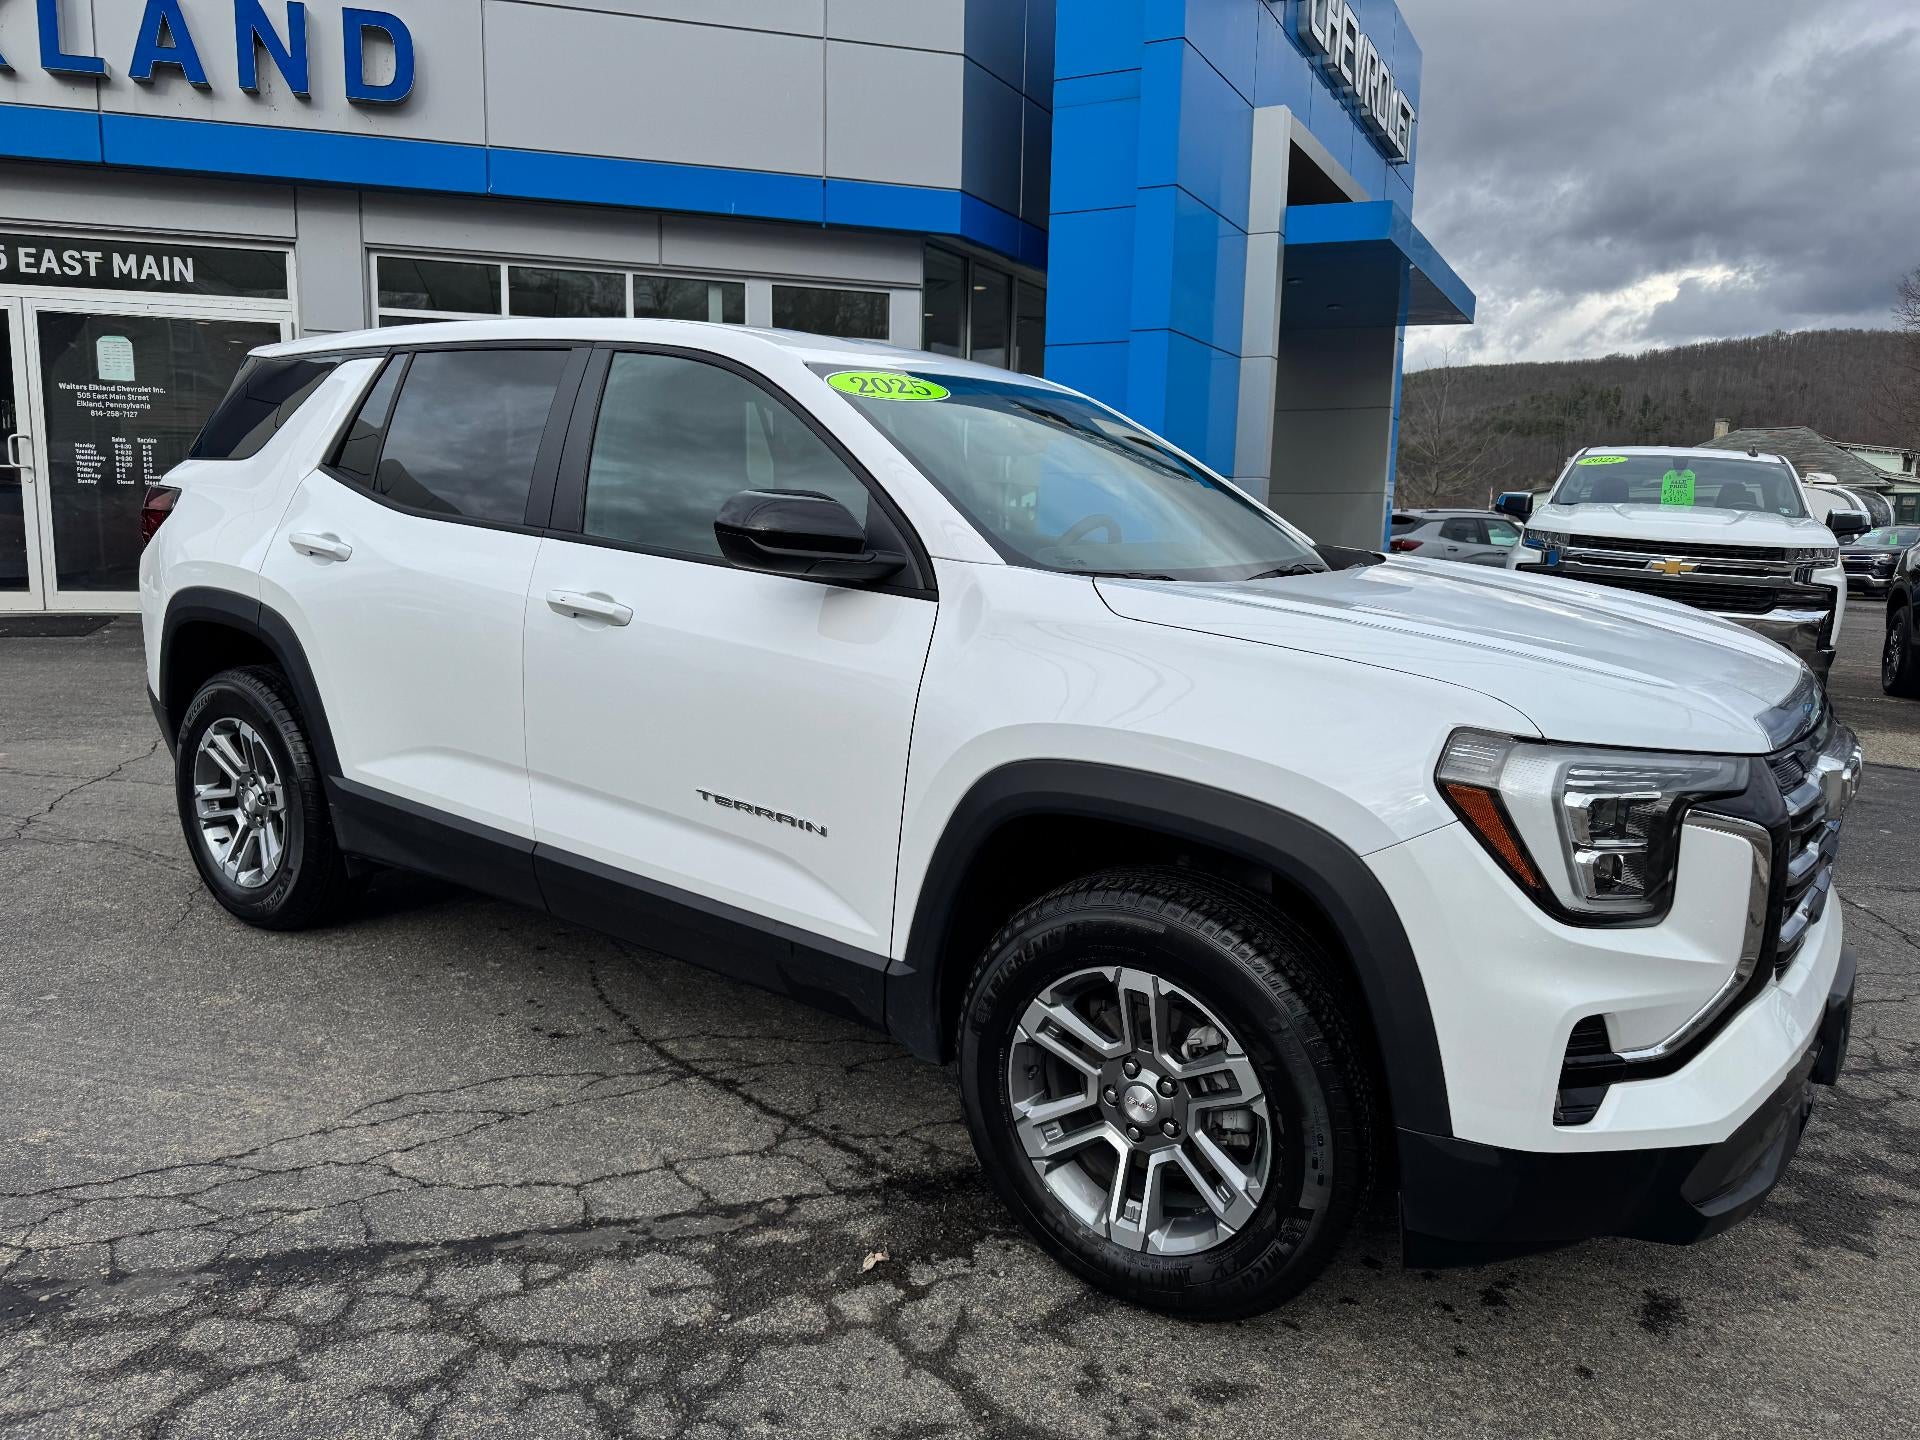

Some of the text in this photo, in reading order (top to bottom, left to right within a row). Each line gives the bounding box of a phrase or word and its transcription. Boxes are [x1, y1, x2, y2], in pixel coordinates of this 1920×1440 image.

[0, 0, 415, 103] LAND
[17, 246, 103, 278] EAST
[112, 252, 195, 284] MAIN
[59, 383, 166, 394] Walters Elkland Chevrolet Inc.
[849, 376, 932, 396] 2025
[92, 392, 108, 400] East
[76, 400, 151, 410] Elkland, Pennsylvania
[90, 410, 138, 418] 814-258-7127
[695, 788, 828, 838] TERRAIN
